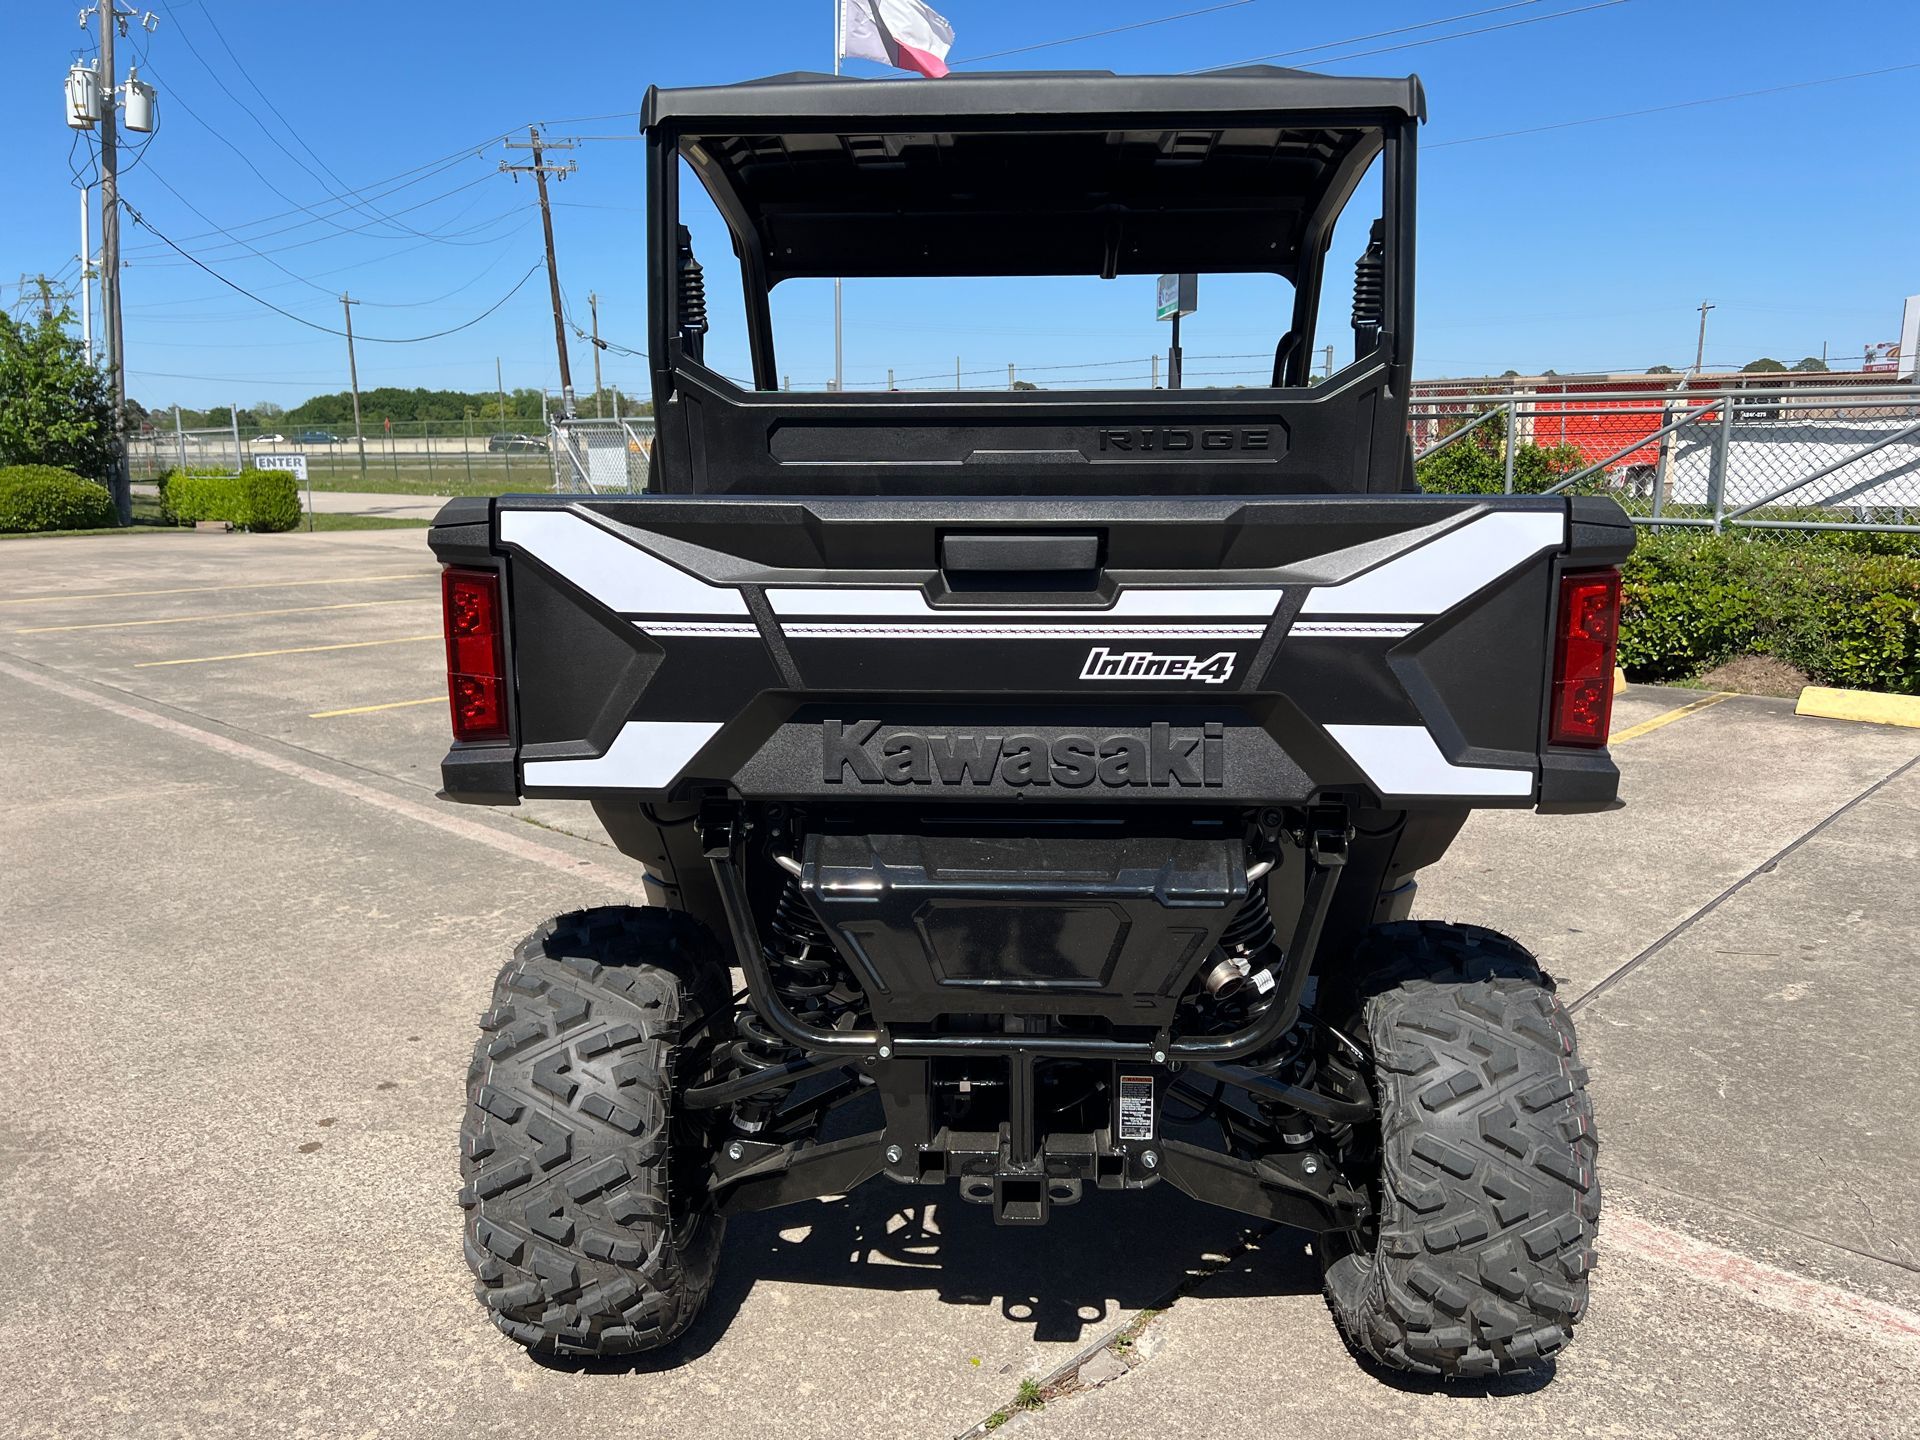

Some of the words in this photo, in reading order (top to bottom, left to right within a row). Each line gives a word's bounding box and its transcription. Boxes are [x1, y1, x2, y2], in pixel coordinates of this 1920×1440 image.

[1099, 429, 1269, 451] RIDGE
[258, 457, 303, 468] ENTER
[1079, 647, 1237, 684] Inline-4
[823, 719, 1224, 787] Kawasaki
